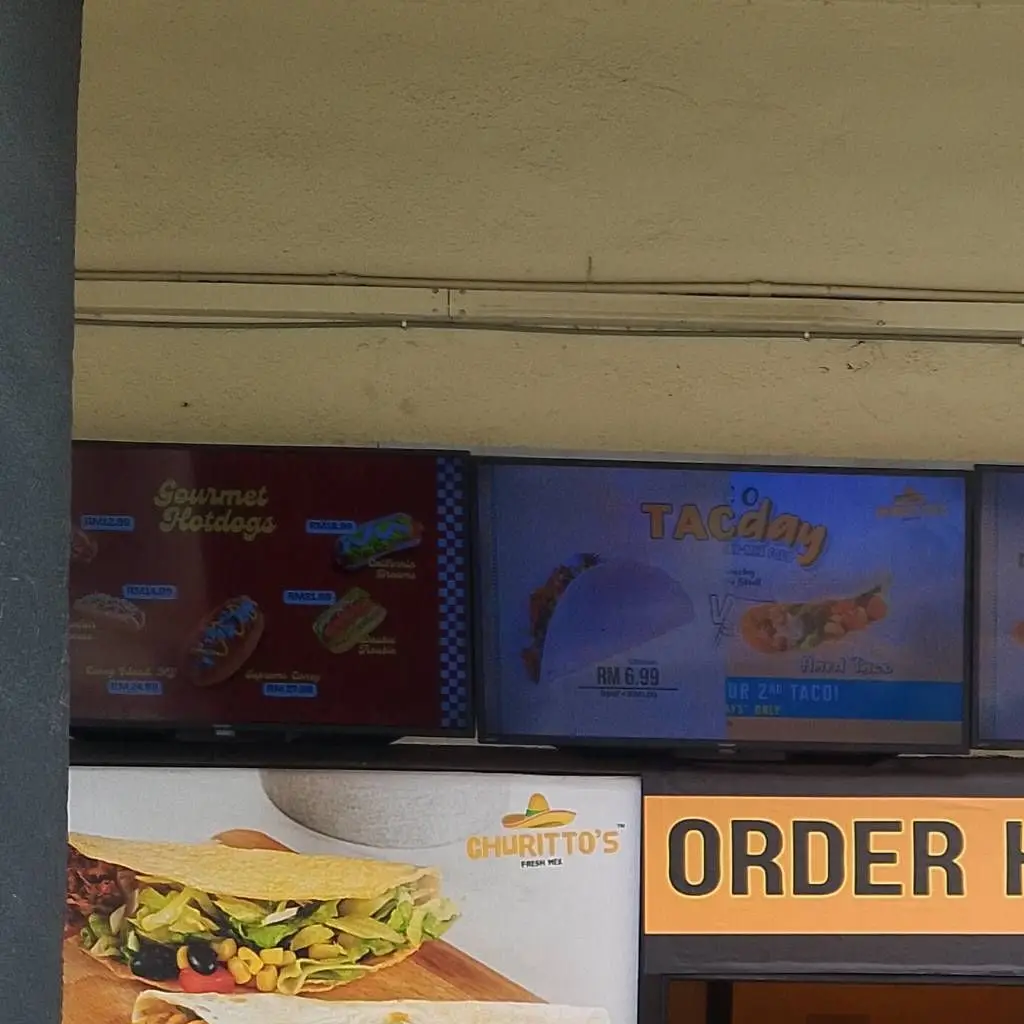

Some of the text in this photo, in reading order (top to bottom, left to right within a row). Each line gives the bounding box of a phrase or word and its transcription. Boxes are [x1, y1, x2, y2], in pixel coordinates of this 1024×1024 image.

[153, 477, 269, 507] Gourmet
[159, 506, 277, 541] Hotdogs
[597, 666, 660, 686] RM 6.99
[466, 829, 620, 860] CHURITTO'S
[668, 818, 966, 898] ORDER
[520, 860, 546, 869] FRESH
